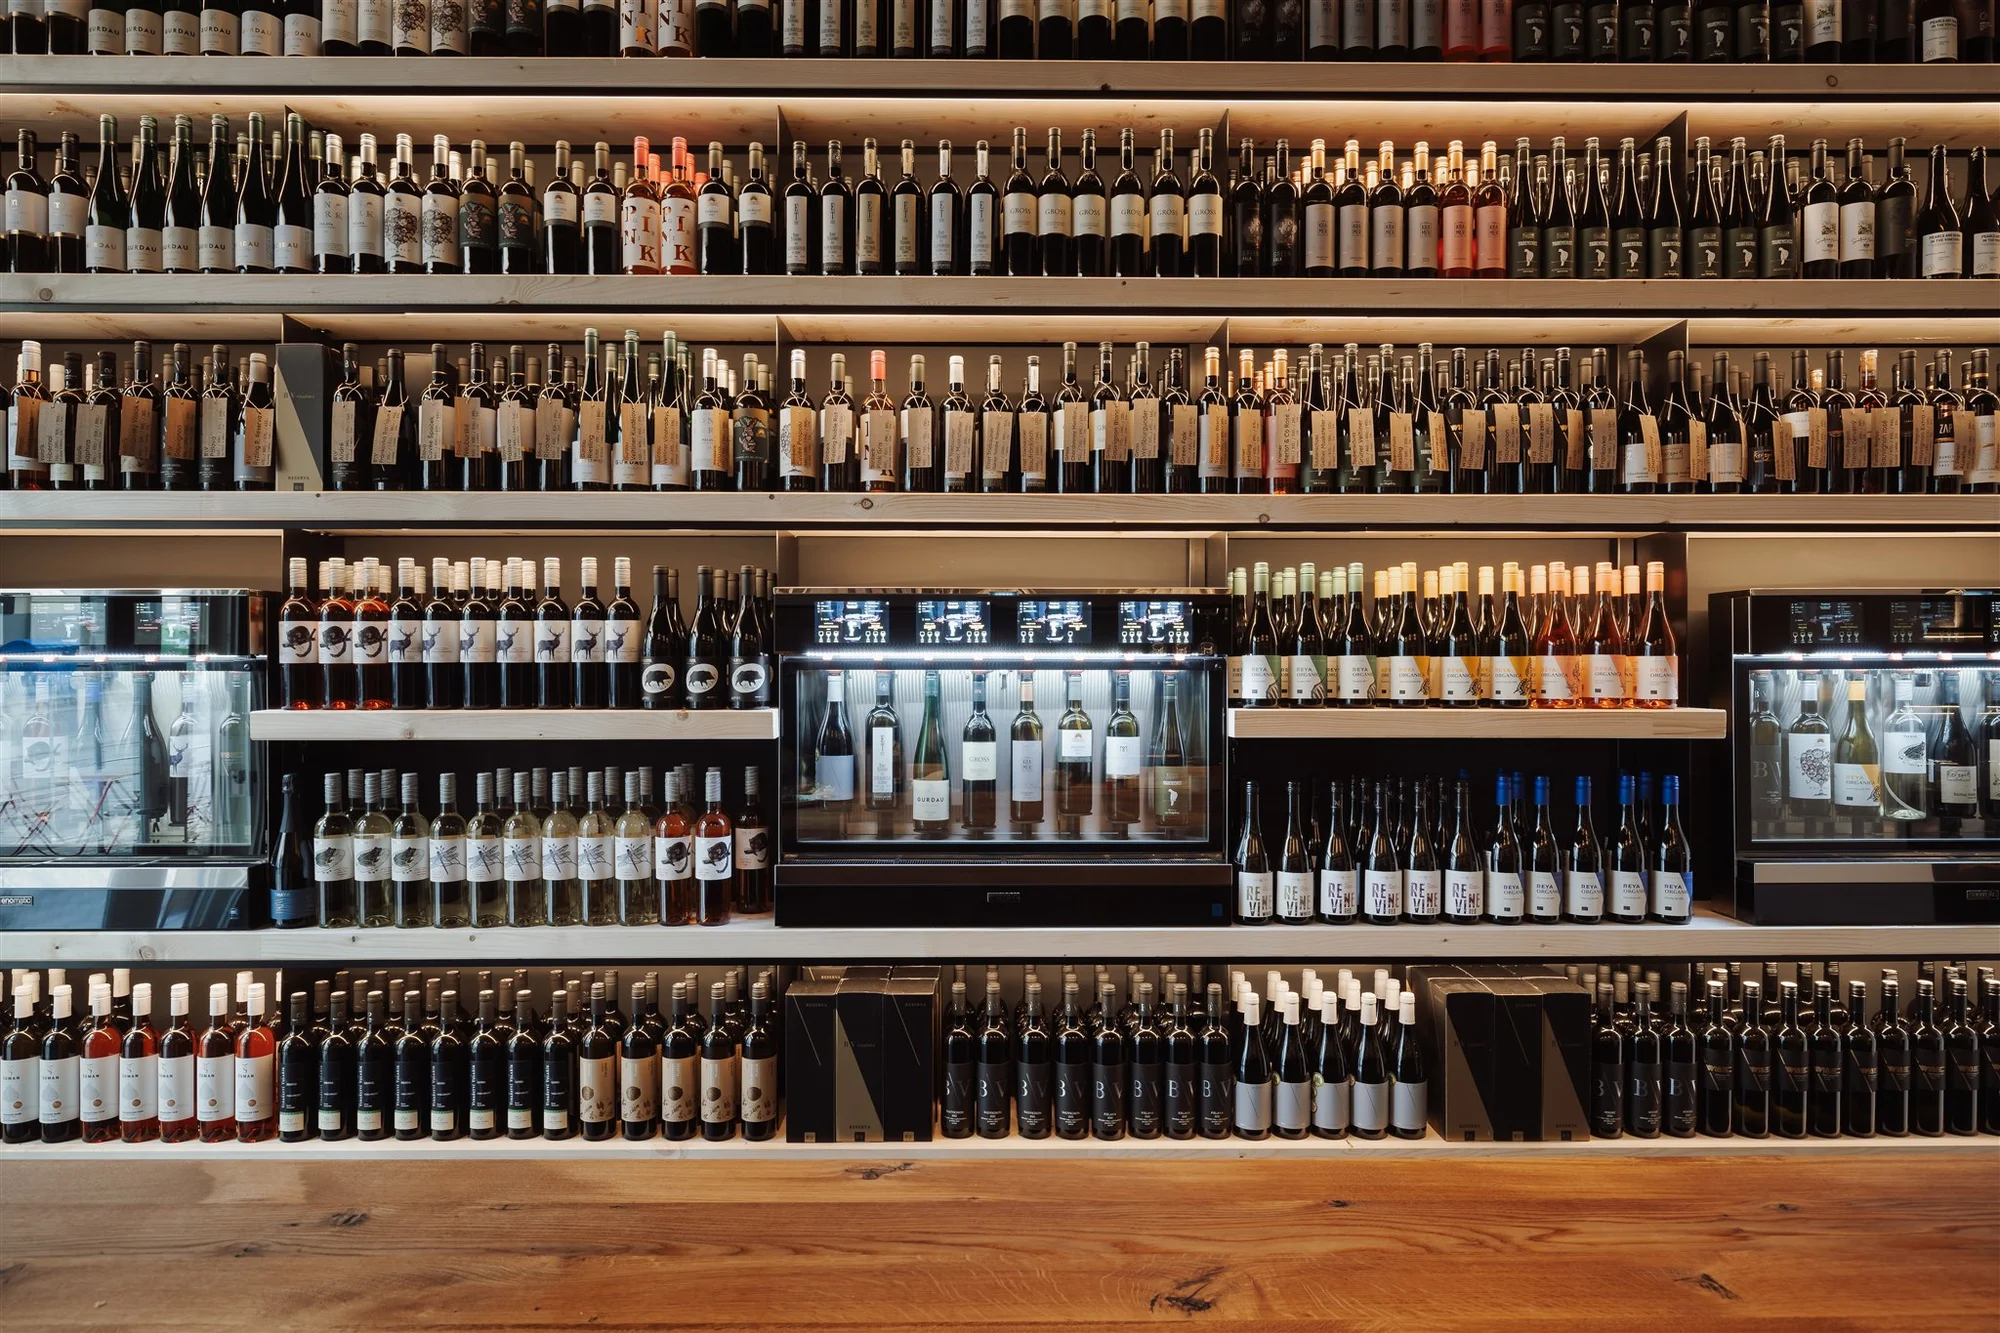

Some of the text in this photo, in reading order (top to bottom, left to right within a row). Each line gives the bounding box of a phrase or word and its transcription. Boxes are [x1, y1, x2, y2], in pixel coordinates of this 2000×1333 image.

[1010, 206, 1031, 215] GROSS
[1044, 207, 1066, 216] GROSS
[1078, 207, 1100, 216] GROSS
[1121, 207, 1141, 216] GROSS
[1156, 207, 1178, 216] GROSS
[1195, 207, 1217, 216] GROSS
[830, 440, 838, 462] Riesling
[1246, 886, 1260, 900] RE
[1284, 886, 1298, 900] RE
[1328, 882, 1342, 898] RE
[1372, 882, 1386, 898] RE
[1410, 882, 1425, 898] RE
[1452, 882, 1467, 898] RE
